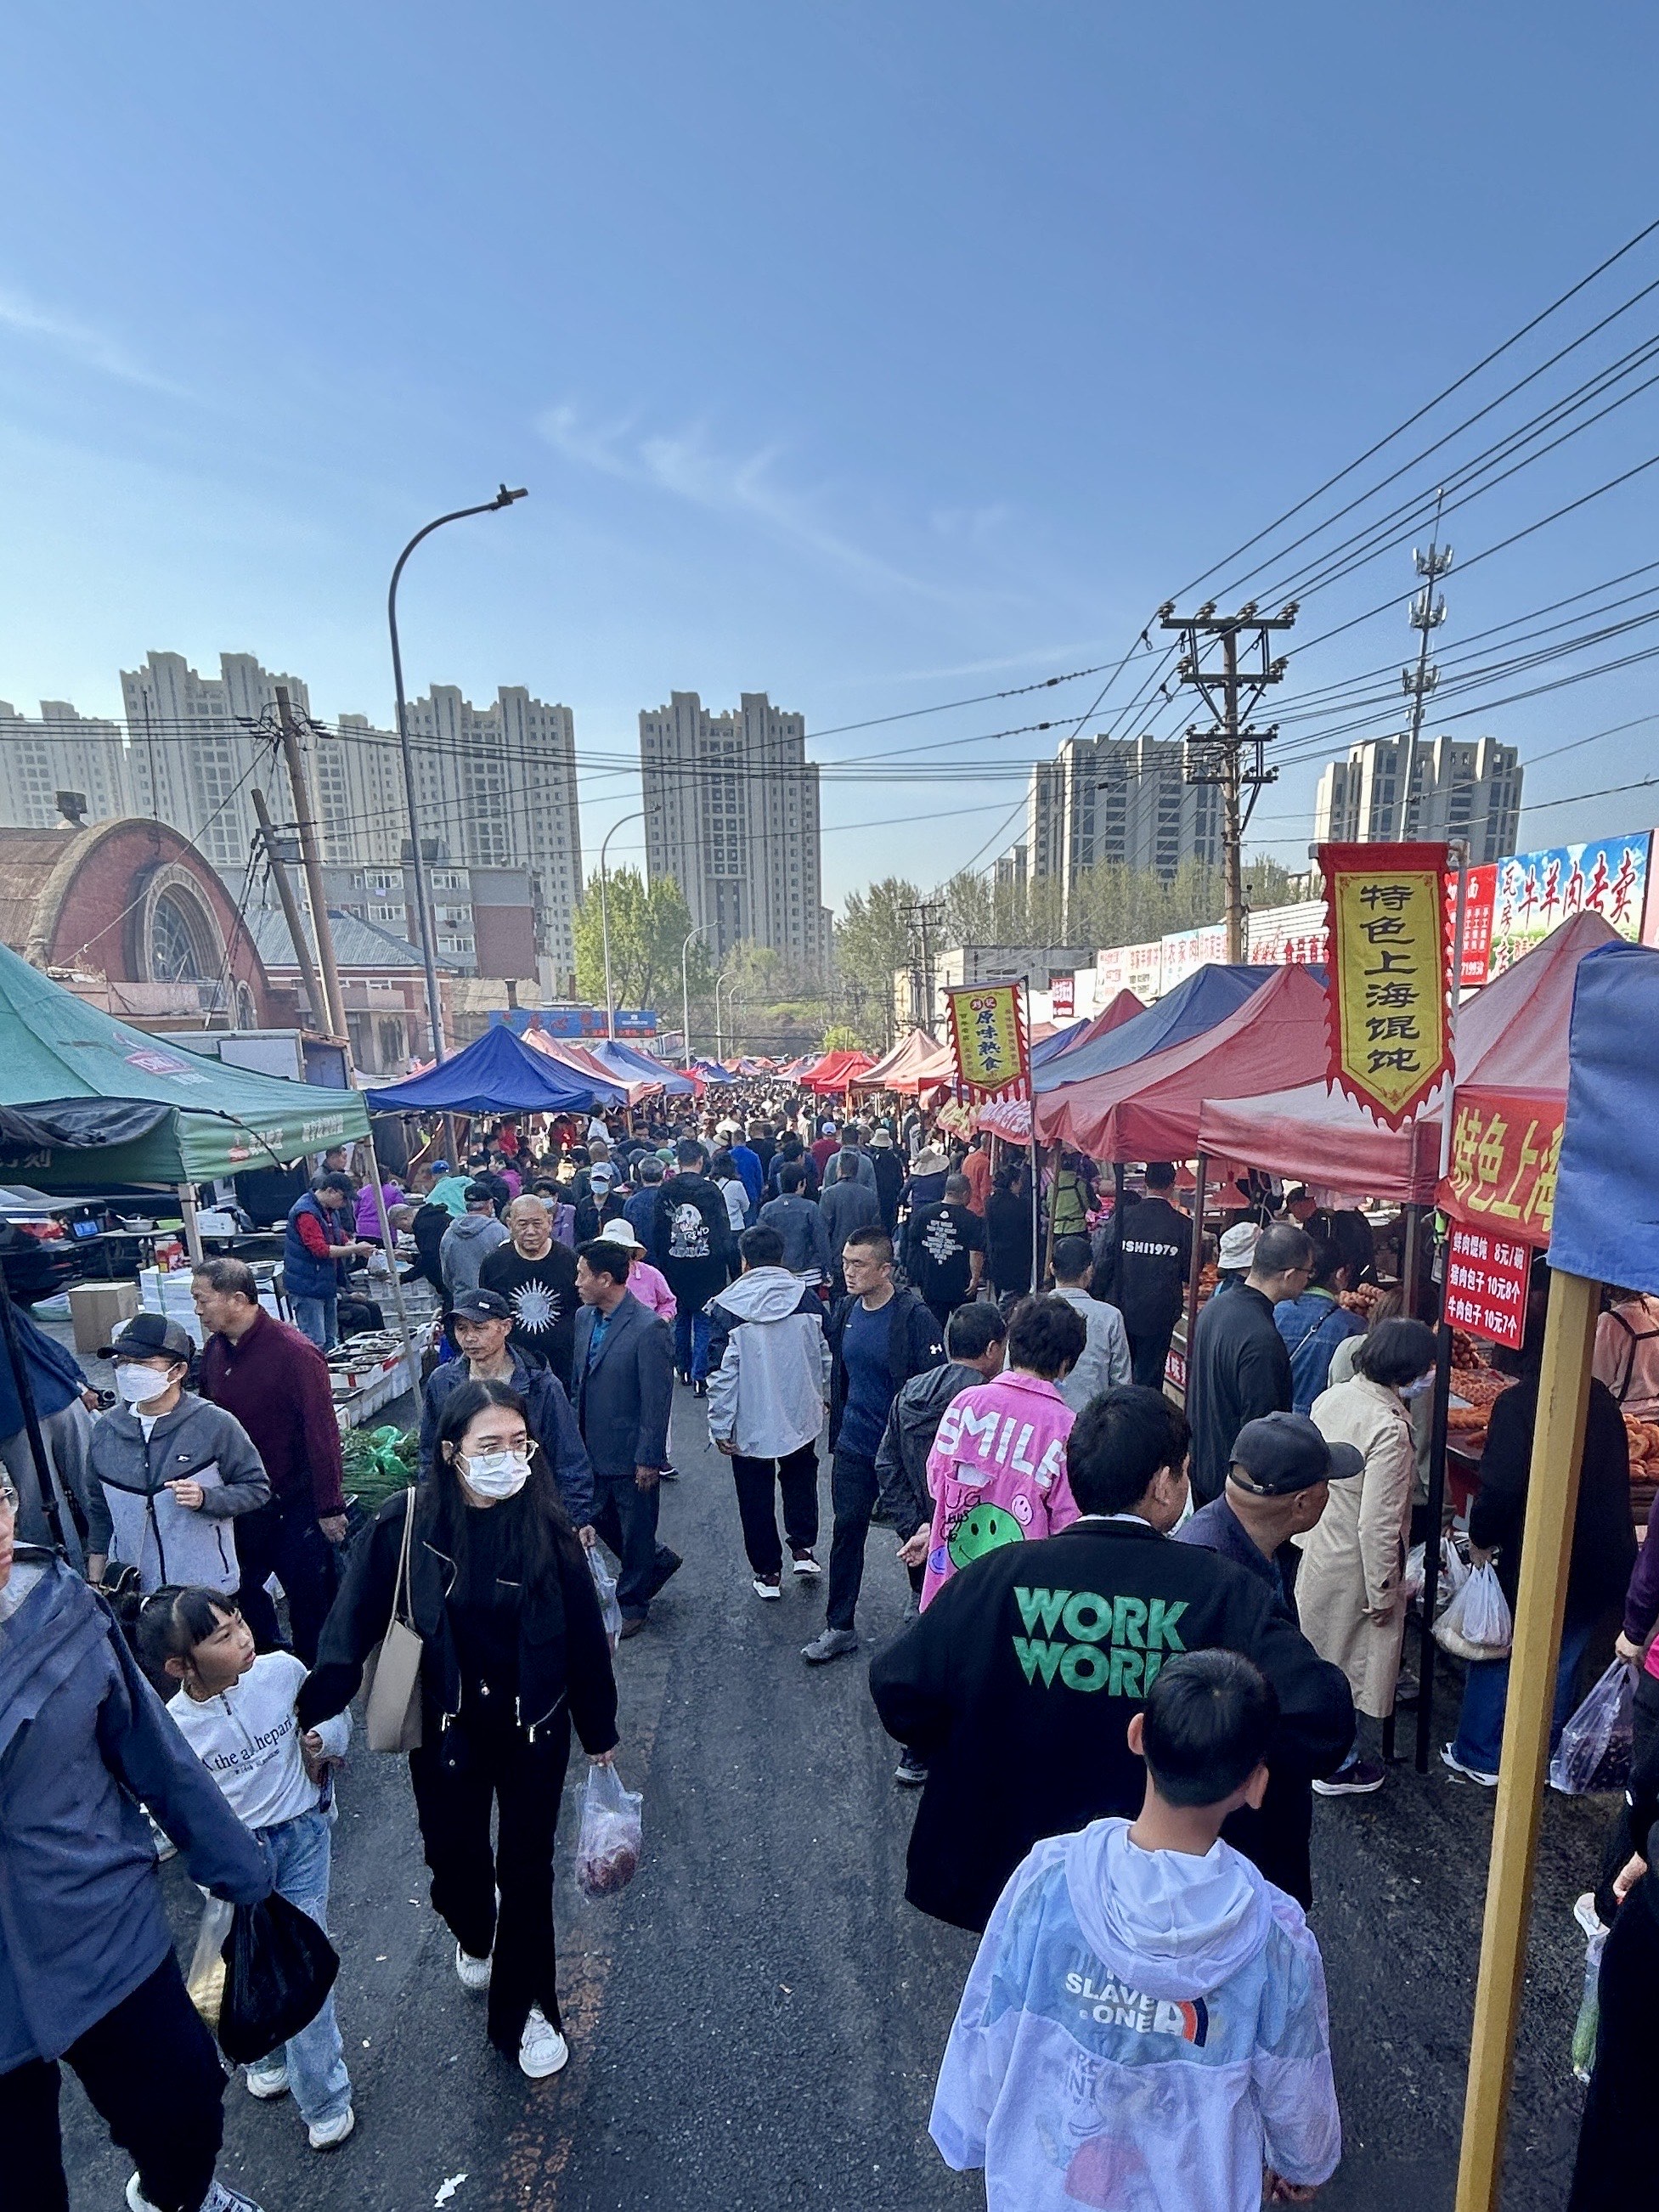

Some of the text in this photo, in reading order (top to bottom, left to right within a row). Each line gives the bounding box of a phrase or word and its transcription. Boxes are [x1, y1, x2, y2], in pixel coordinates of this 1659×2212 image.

[1359, 884, 1420, 1073] 特色上海馄饨
[975, 1009, 1004, 1071] 原味熟食
[1450, 1263, 1521, 1305] 猪肉包子 10元8个
[1447, 1295, 1517, 1339] 牛肉包子 10元7个
[937, 1406, 1067, 1489] SMILE
[1013, 1586, 1190, 1651] WORK
[214, 1752, 238, 1769] the
[1065, 1972, 1156, 2012] SLAVE
[1092, 2004, 1152, 2034] ONE
